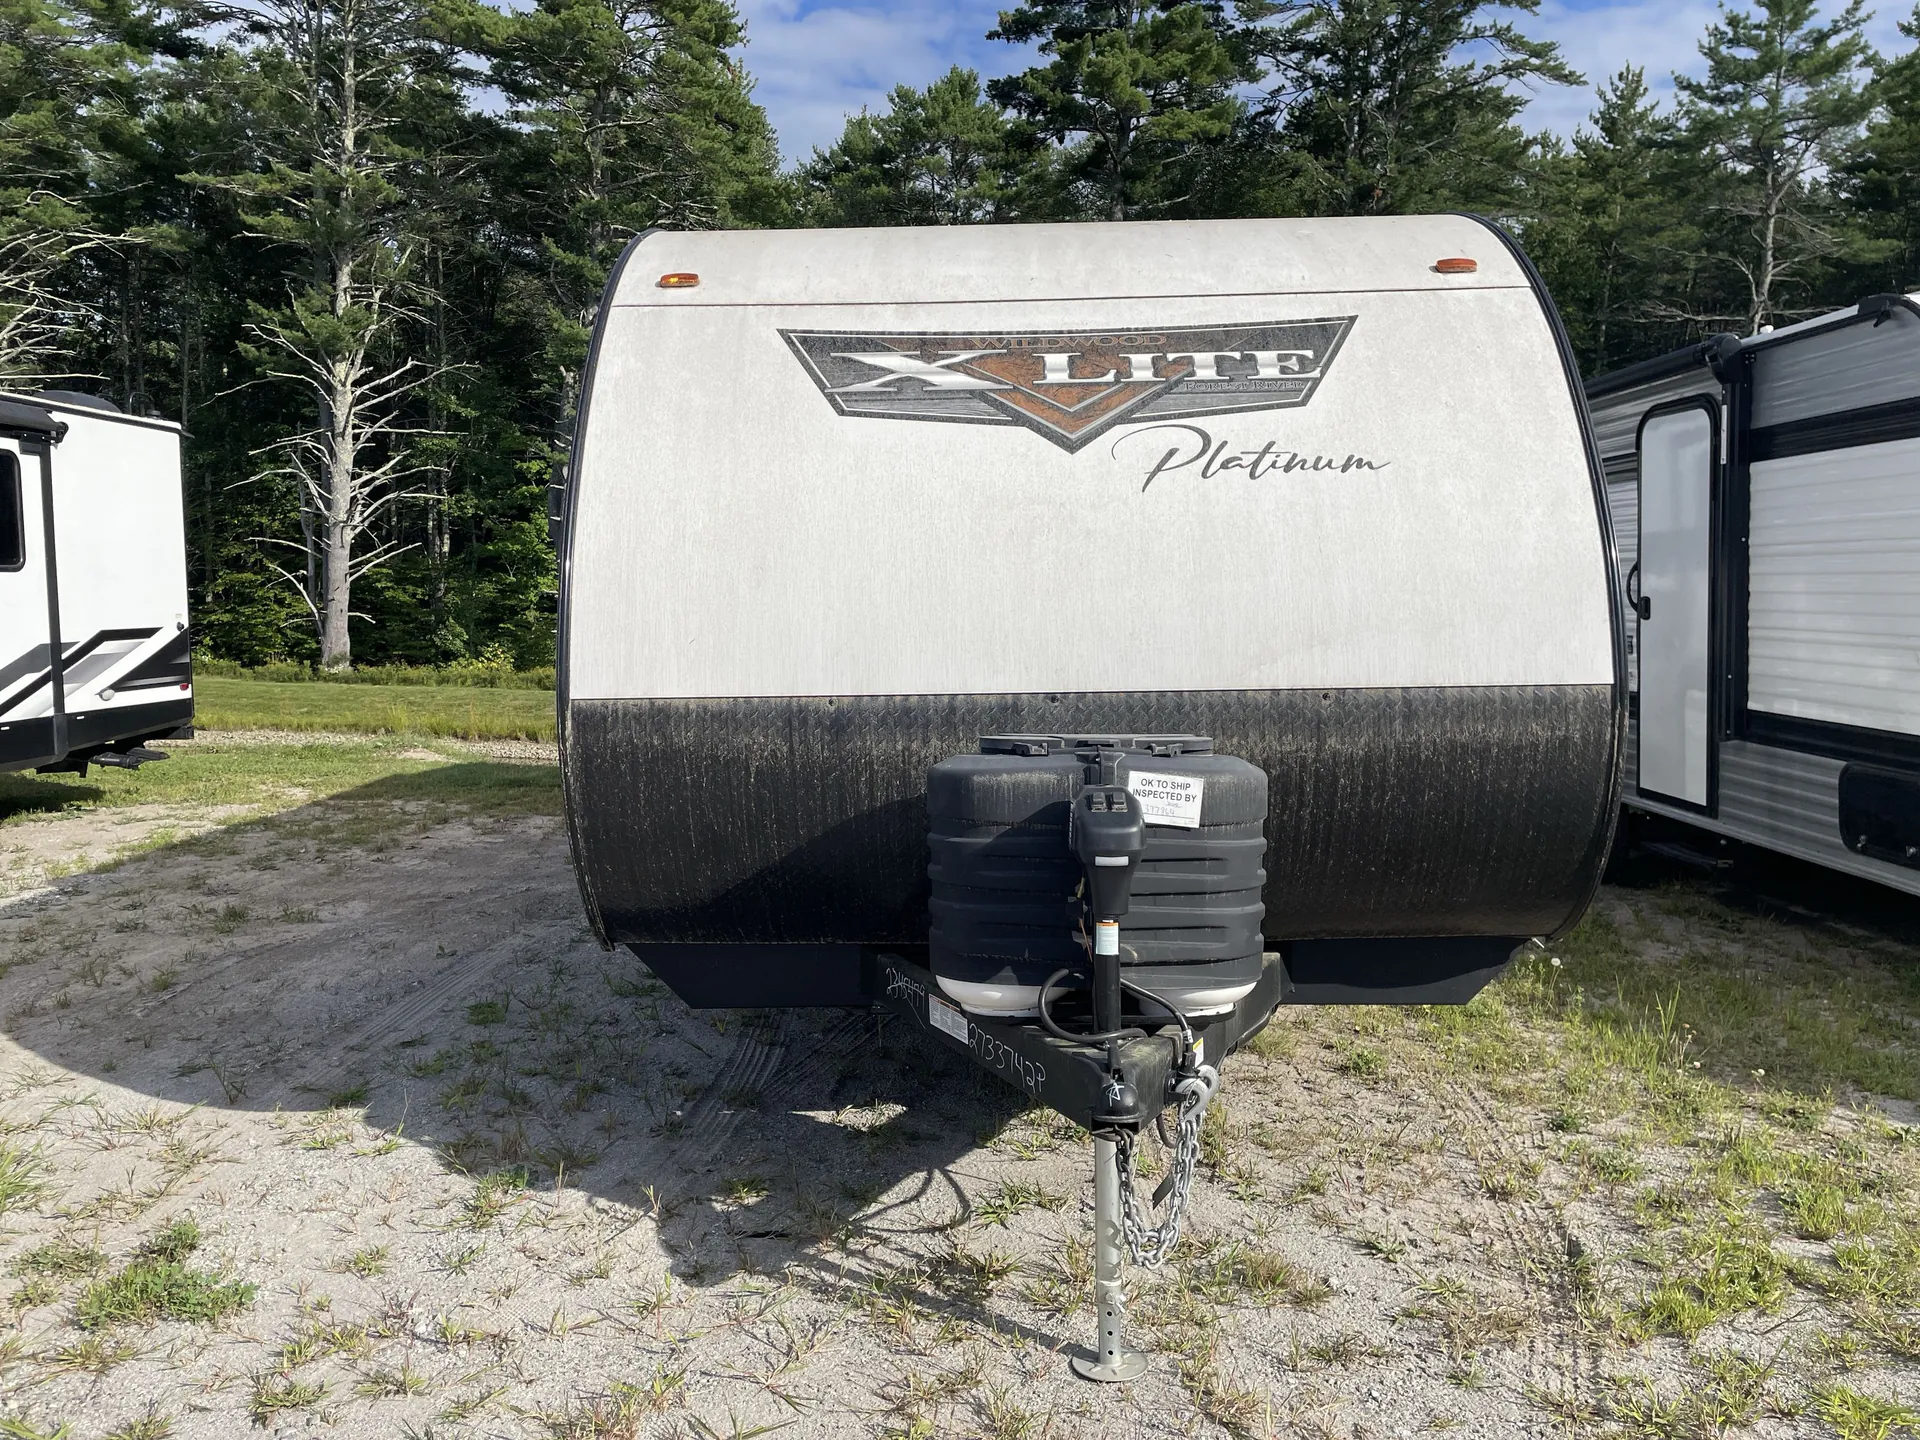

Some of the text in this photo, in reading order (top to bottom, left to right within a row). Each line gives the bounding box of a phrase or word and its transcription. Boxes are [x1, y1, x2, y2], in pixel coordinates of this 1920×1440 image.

[969, 334, 1167, 349] WILDWOOD
[825, 349, 1322, 392] X LITE
[1184, 380, 1305, 391] FOREST RIVER
[1111, 424, 1392, 493] Platinum
[1140, 778, 1191, 791] OK TO SHIP
[1132, 788, 1197, 802] INSPECTED BY
